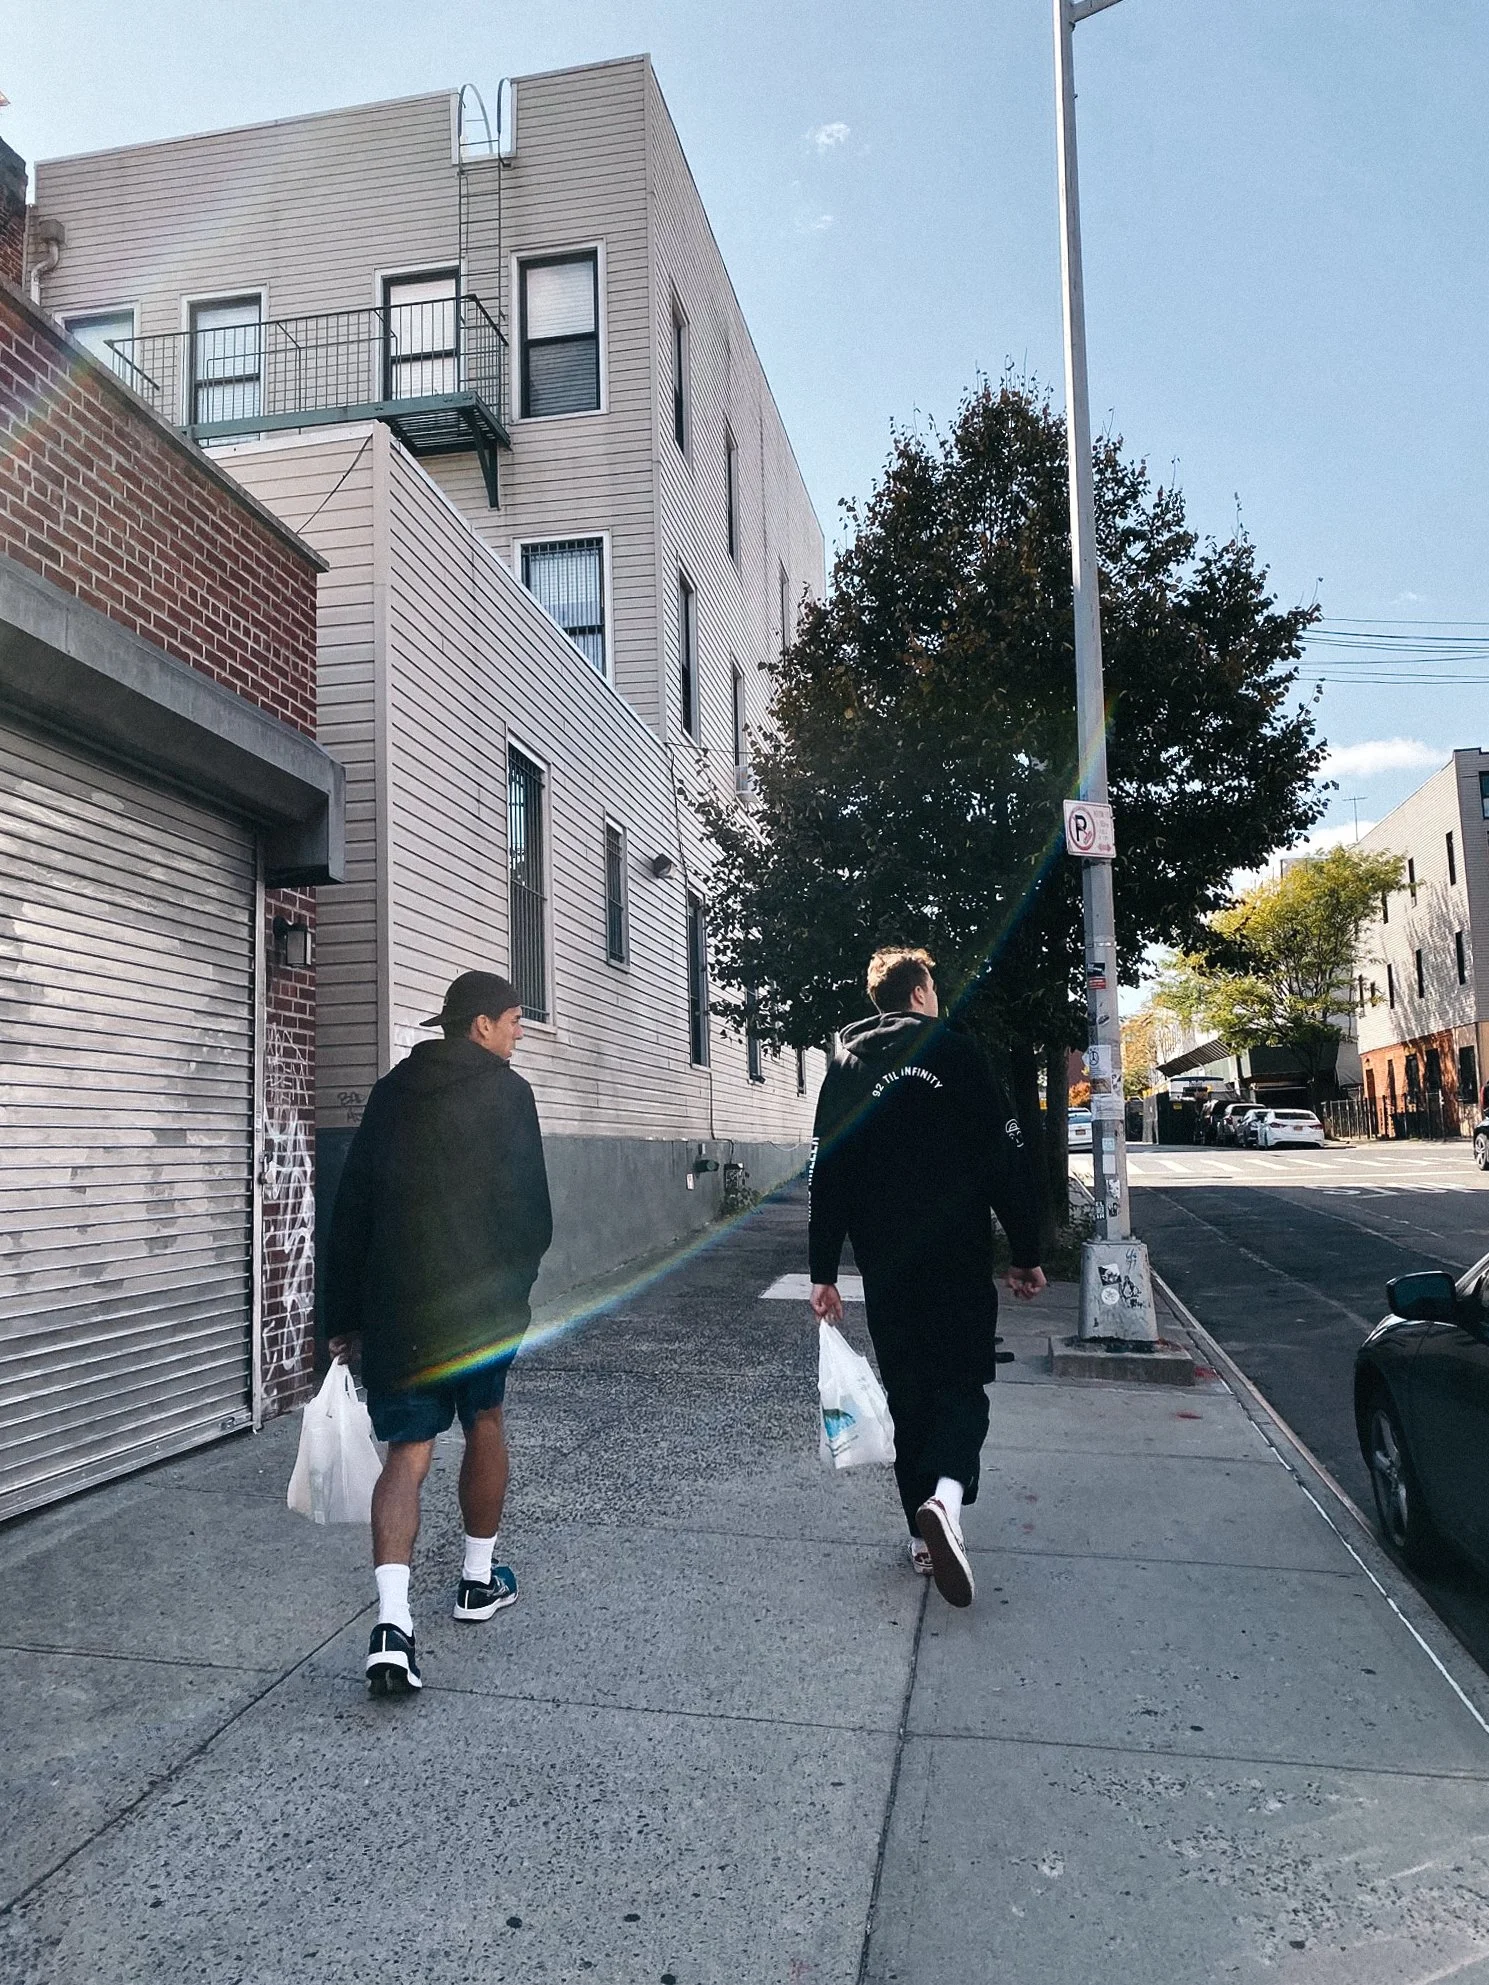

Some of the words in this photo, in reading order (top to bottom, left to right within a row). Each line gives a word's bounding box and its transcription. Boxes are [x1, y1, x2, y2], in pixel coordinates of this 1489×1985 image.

[1075, 815, 1087, 842] P
[872, 1083, 885, 1097] 92
[882, 1071, 900, 1084] TIL
[901, 1066, 943, 1089] INFINITY
